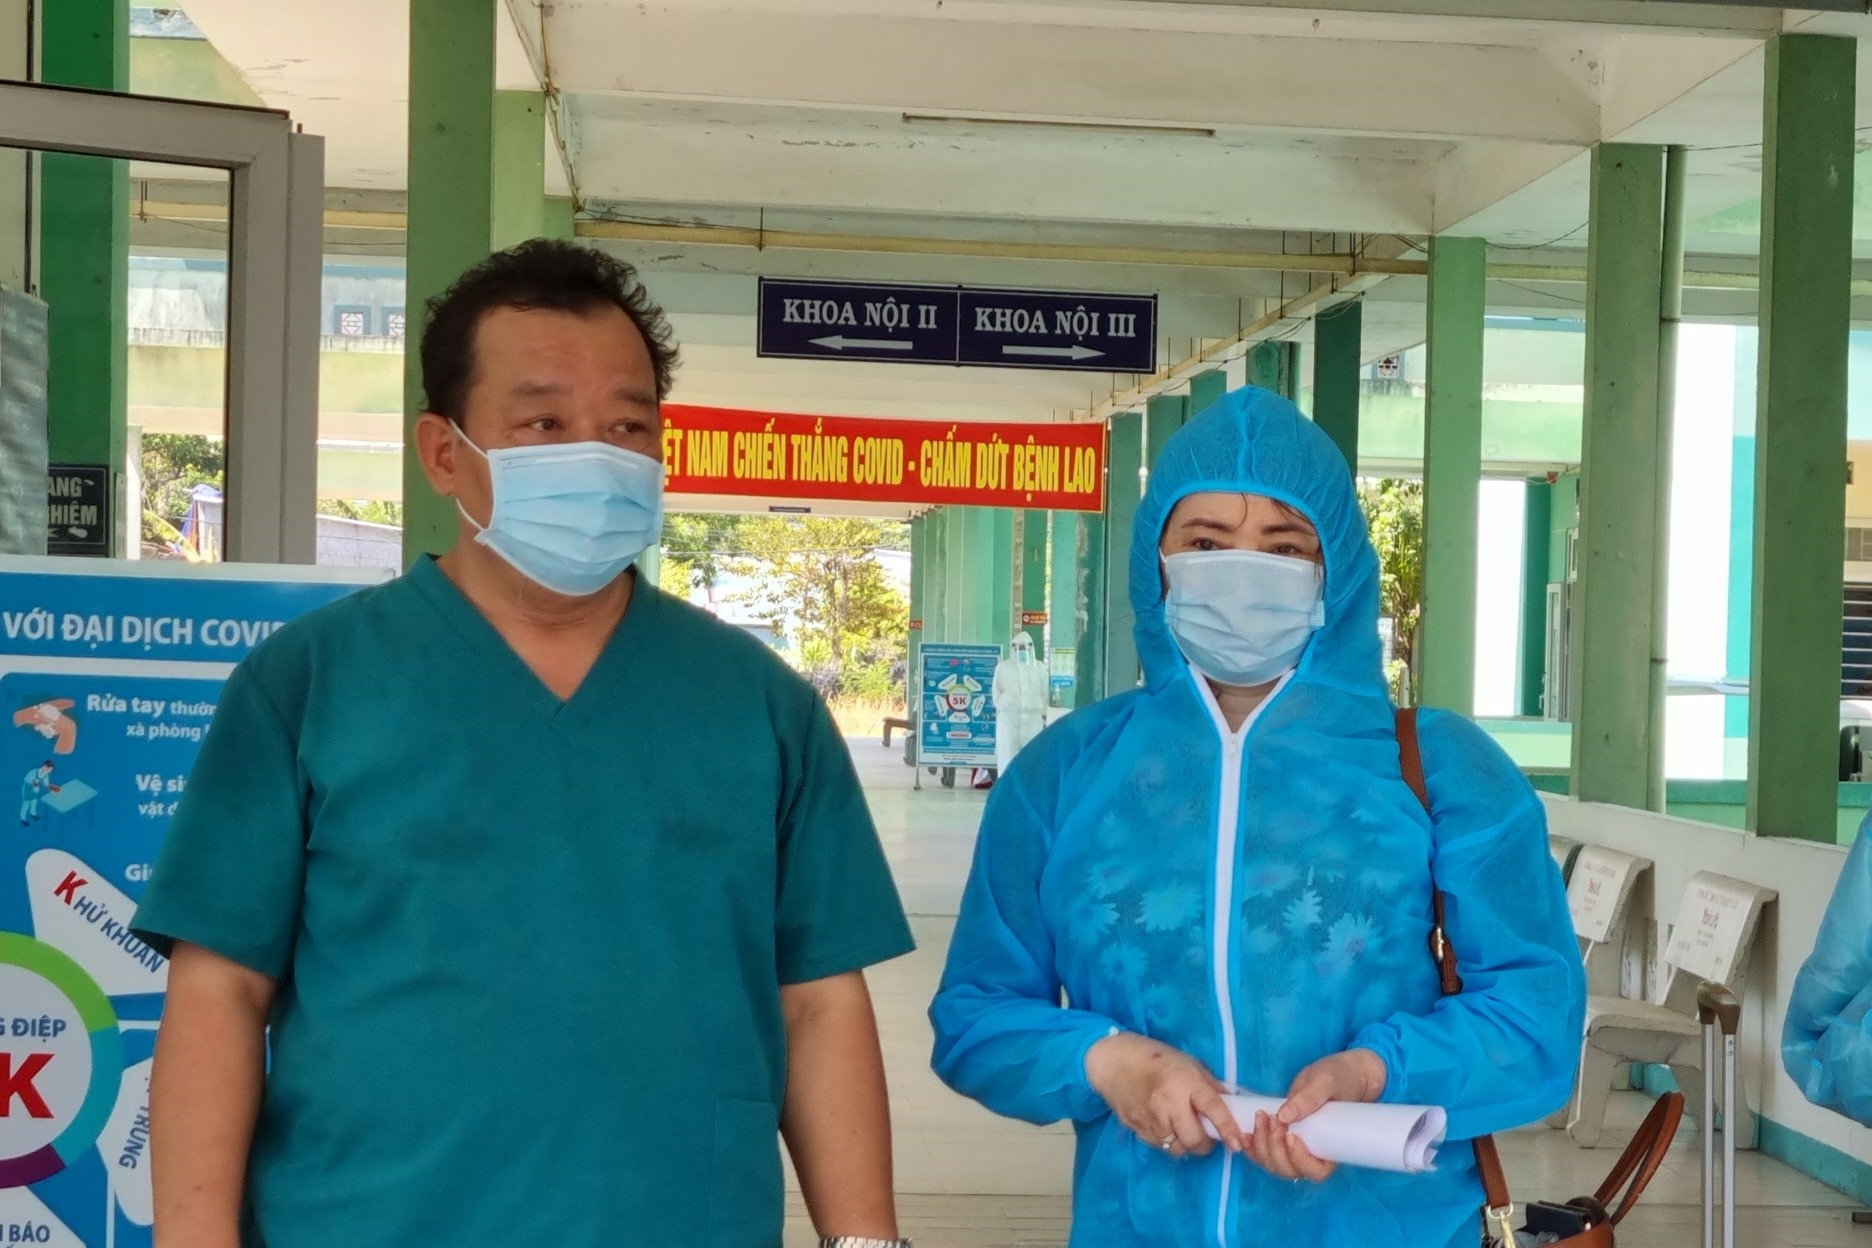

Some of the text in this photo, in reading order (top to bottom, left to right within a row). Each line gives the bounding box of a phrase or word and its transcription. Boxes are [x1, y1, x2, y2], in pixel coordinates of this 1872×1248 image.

[783, 296, 937, 329] KHOA NỘI II
[975, 305, 1136, 340] KHOA NỘI III
[688, 431, 728, 477] NAM
[734, 419, 785, 480] CHIẾN
[791, 418, 848, 483] THẮNG
[854, 438, 903, 484] COVID
[920, 426, 970, 487] CHẤM
[976, 434, 1009, 489] DỨT
[1014, 436, 1060, 501] BỆNH
[1064, 447, 1095, 493] LAO
[3, 607, 193, 650] VỚI ĐẠI DỊCH
[87, 693, 164, 717] Rửa tay
[126, 723, 144, 736] xà
[150, 725, 201, 742] phòng
[136, 775, 163, 796] Vệ
[12, 1014, 66, 1042] ĐIỆP
[10, 1220, 50, 1242] BÁO
